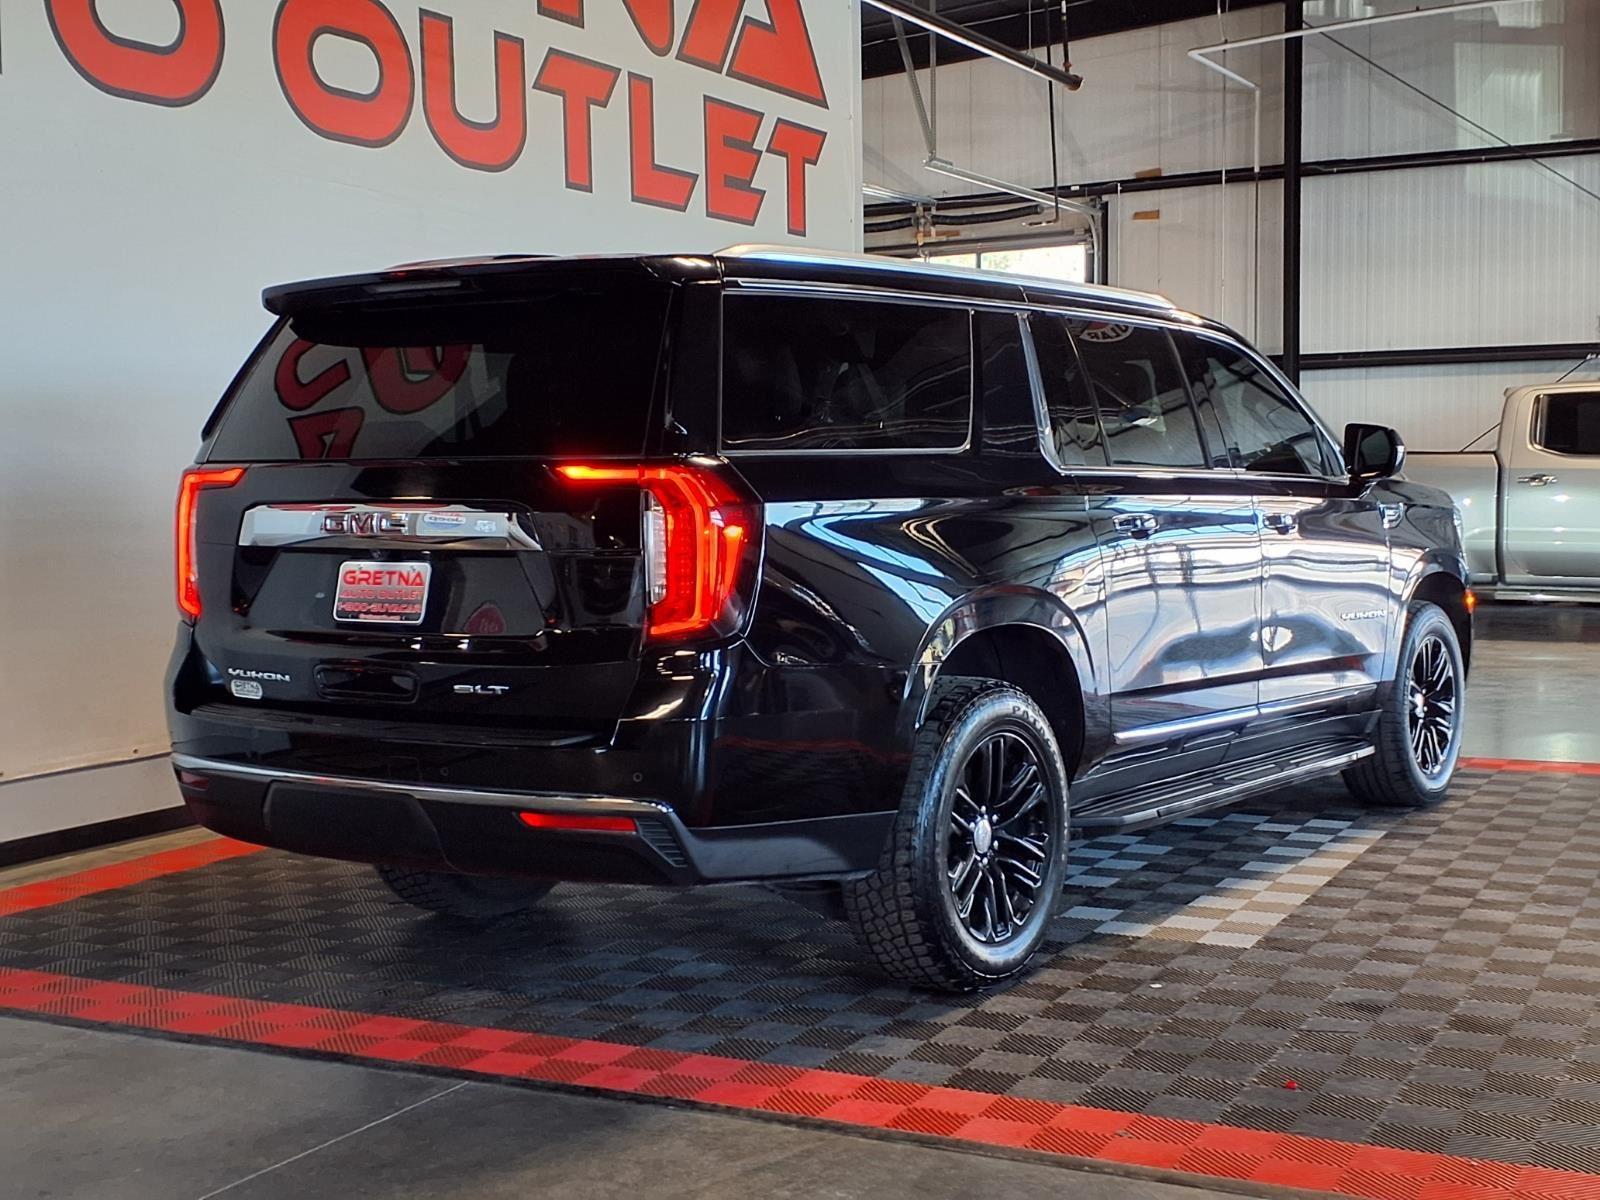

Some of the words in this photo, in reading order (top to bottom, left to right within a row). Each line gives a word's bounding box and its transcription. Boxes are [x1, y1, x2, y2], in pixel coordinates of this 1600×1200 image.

[272, 0, 828, 237] OUTLET
[322, 512, 408, 535] GMC
[343, 570, 424, 587] GRETNA
[1340, 608, 1388, 621] YUKON
[227, 667, 290, 682] YUKON
[453, 684, 510, 695] SLT
